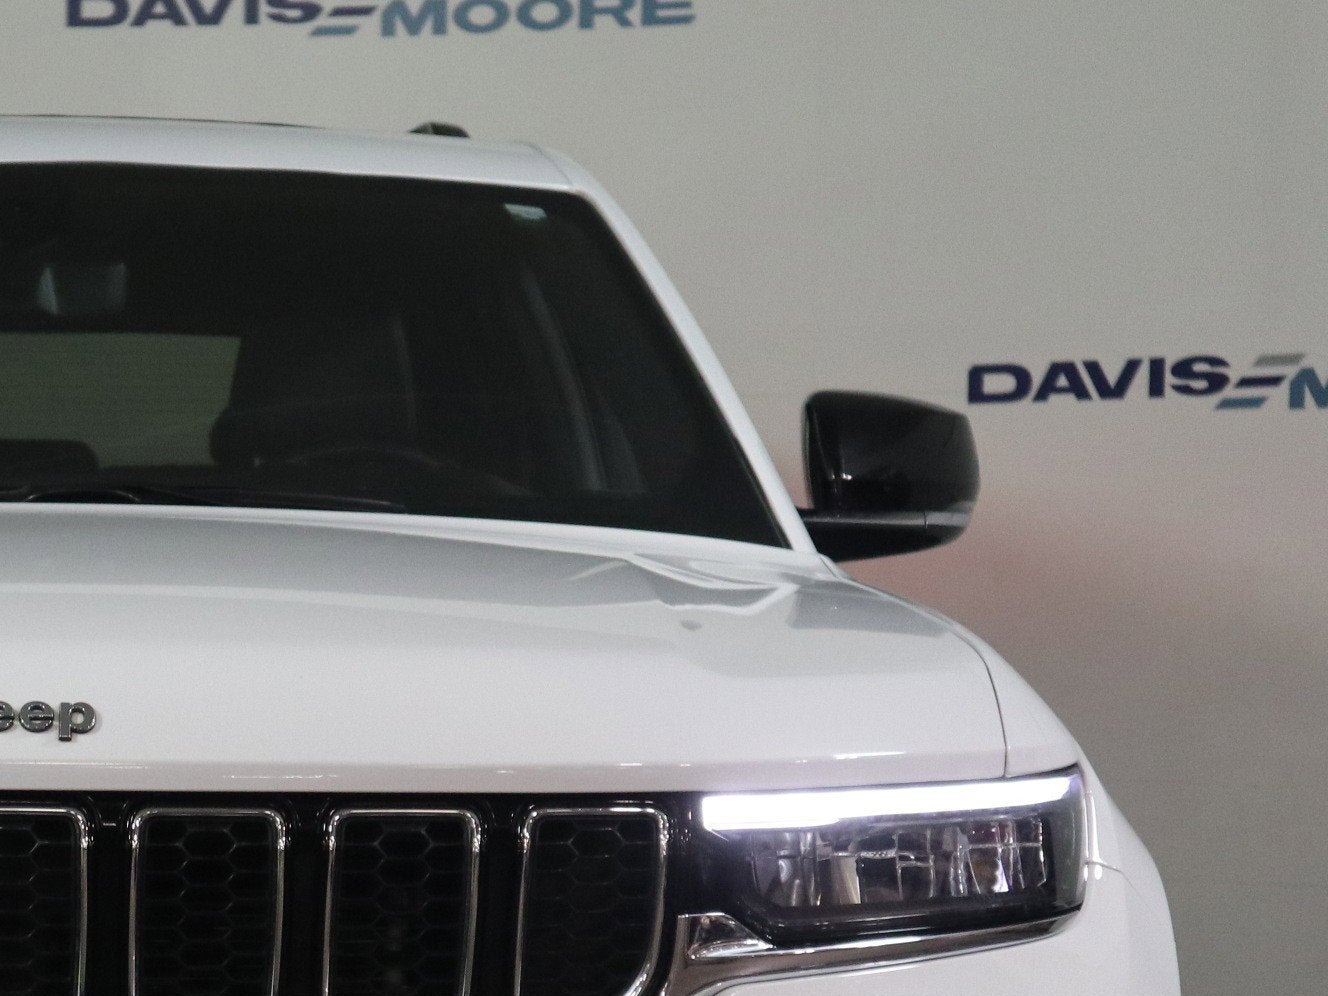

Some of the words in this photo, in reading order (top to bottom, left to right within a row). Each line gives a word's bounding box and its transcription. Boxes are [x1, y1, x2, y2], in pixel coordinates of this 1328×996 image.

[65, 0, 324, 27] DAVIS
[380, 0, 696, 37] MOORE
[967, 354, 1232, 403] DAVIS
